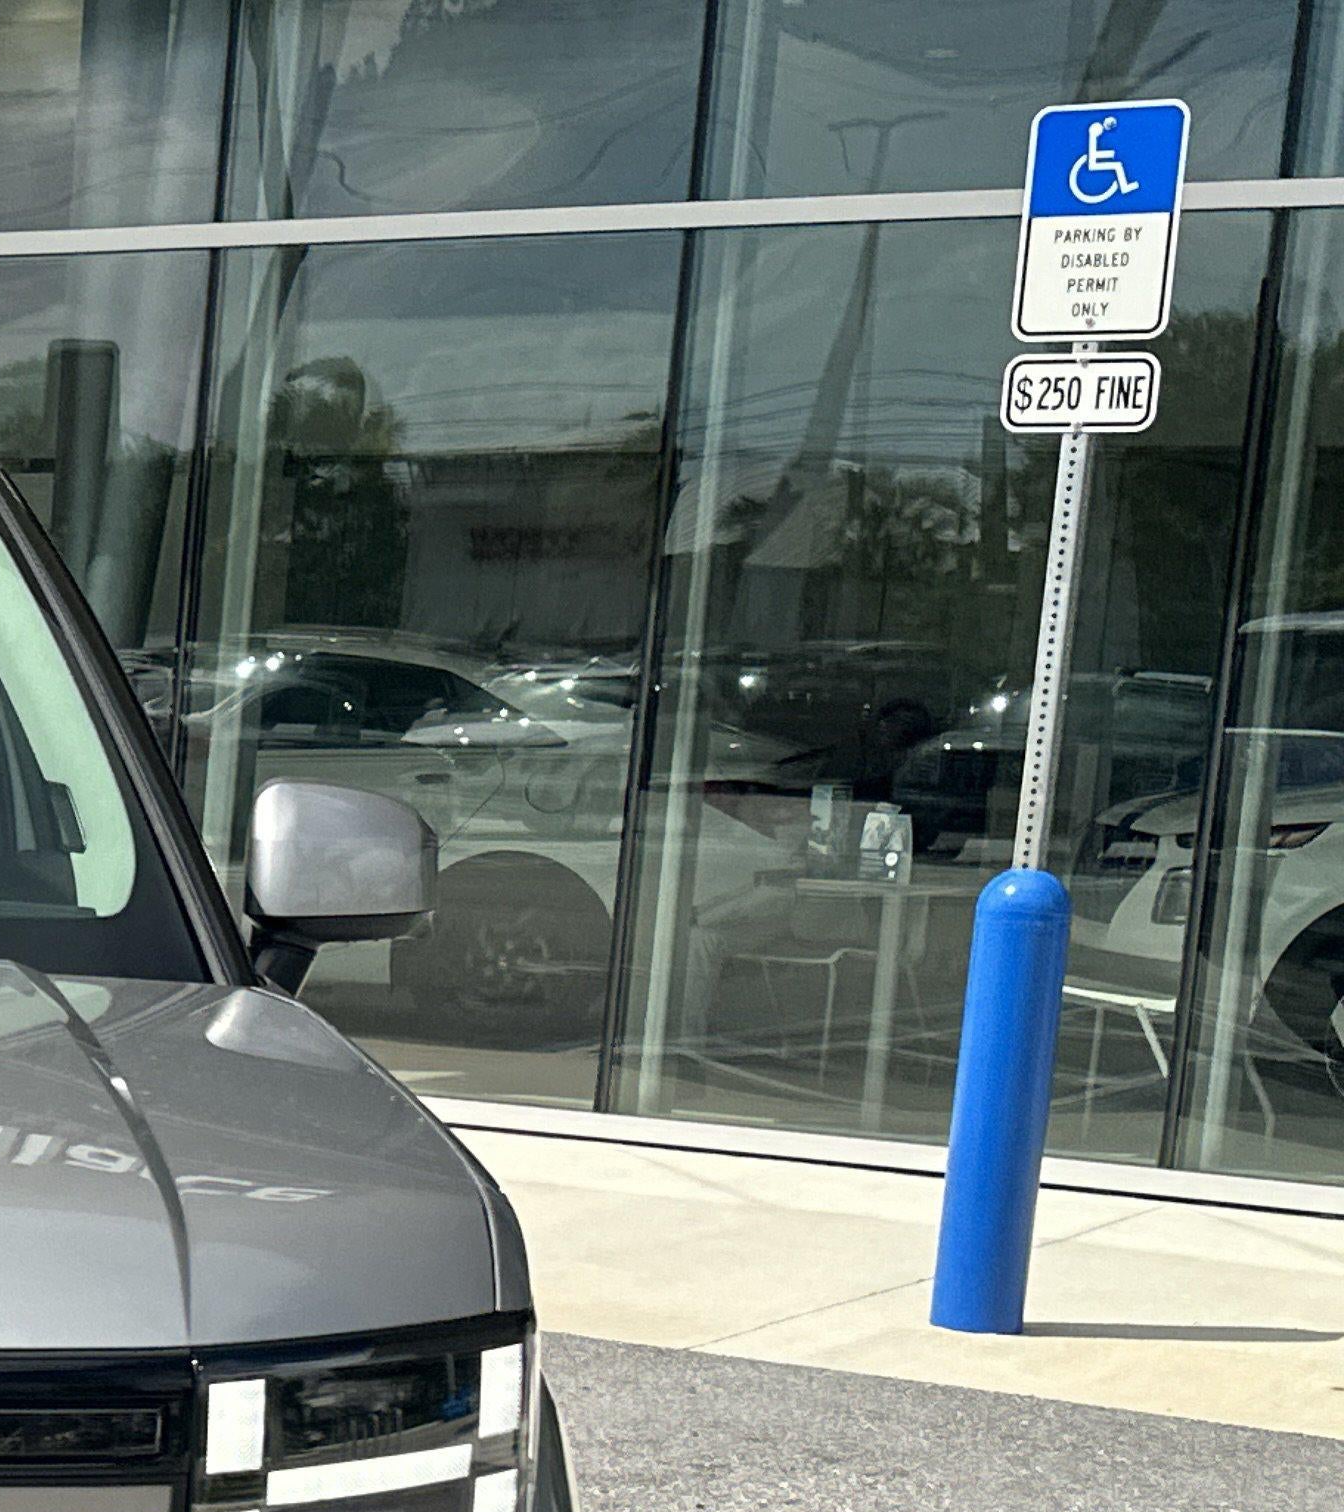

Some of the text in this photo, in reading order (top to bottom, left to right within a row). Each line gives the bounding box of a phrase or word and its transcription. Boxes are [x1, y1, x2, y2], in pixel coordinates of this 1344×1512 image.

[1054, 227, 1143, 244] PARKING BY
[1061, 252, 1130, 269] DISABLED
[1067, 277, 1119, 293] PERMIT
[1071, 302, 1109, 317] ONLY
[1014, 375, 1147, 414] $250 FINE
